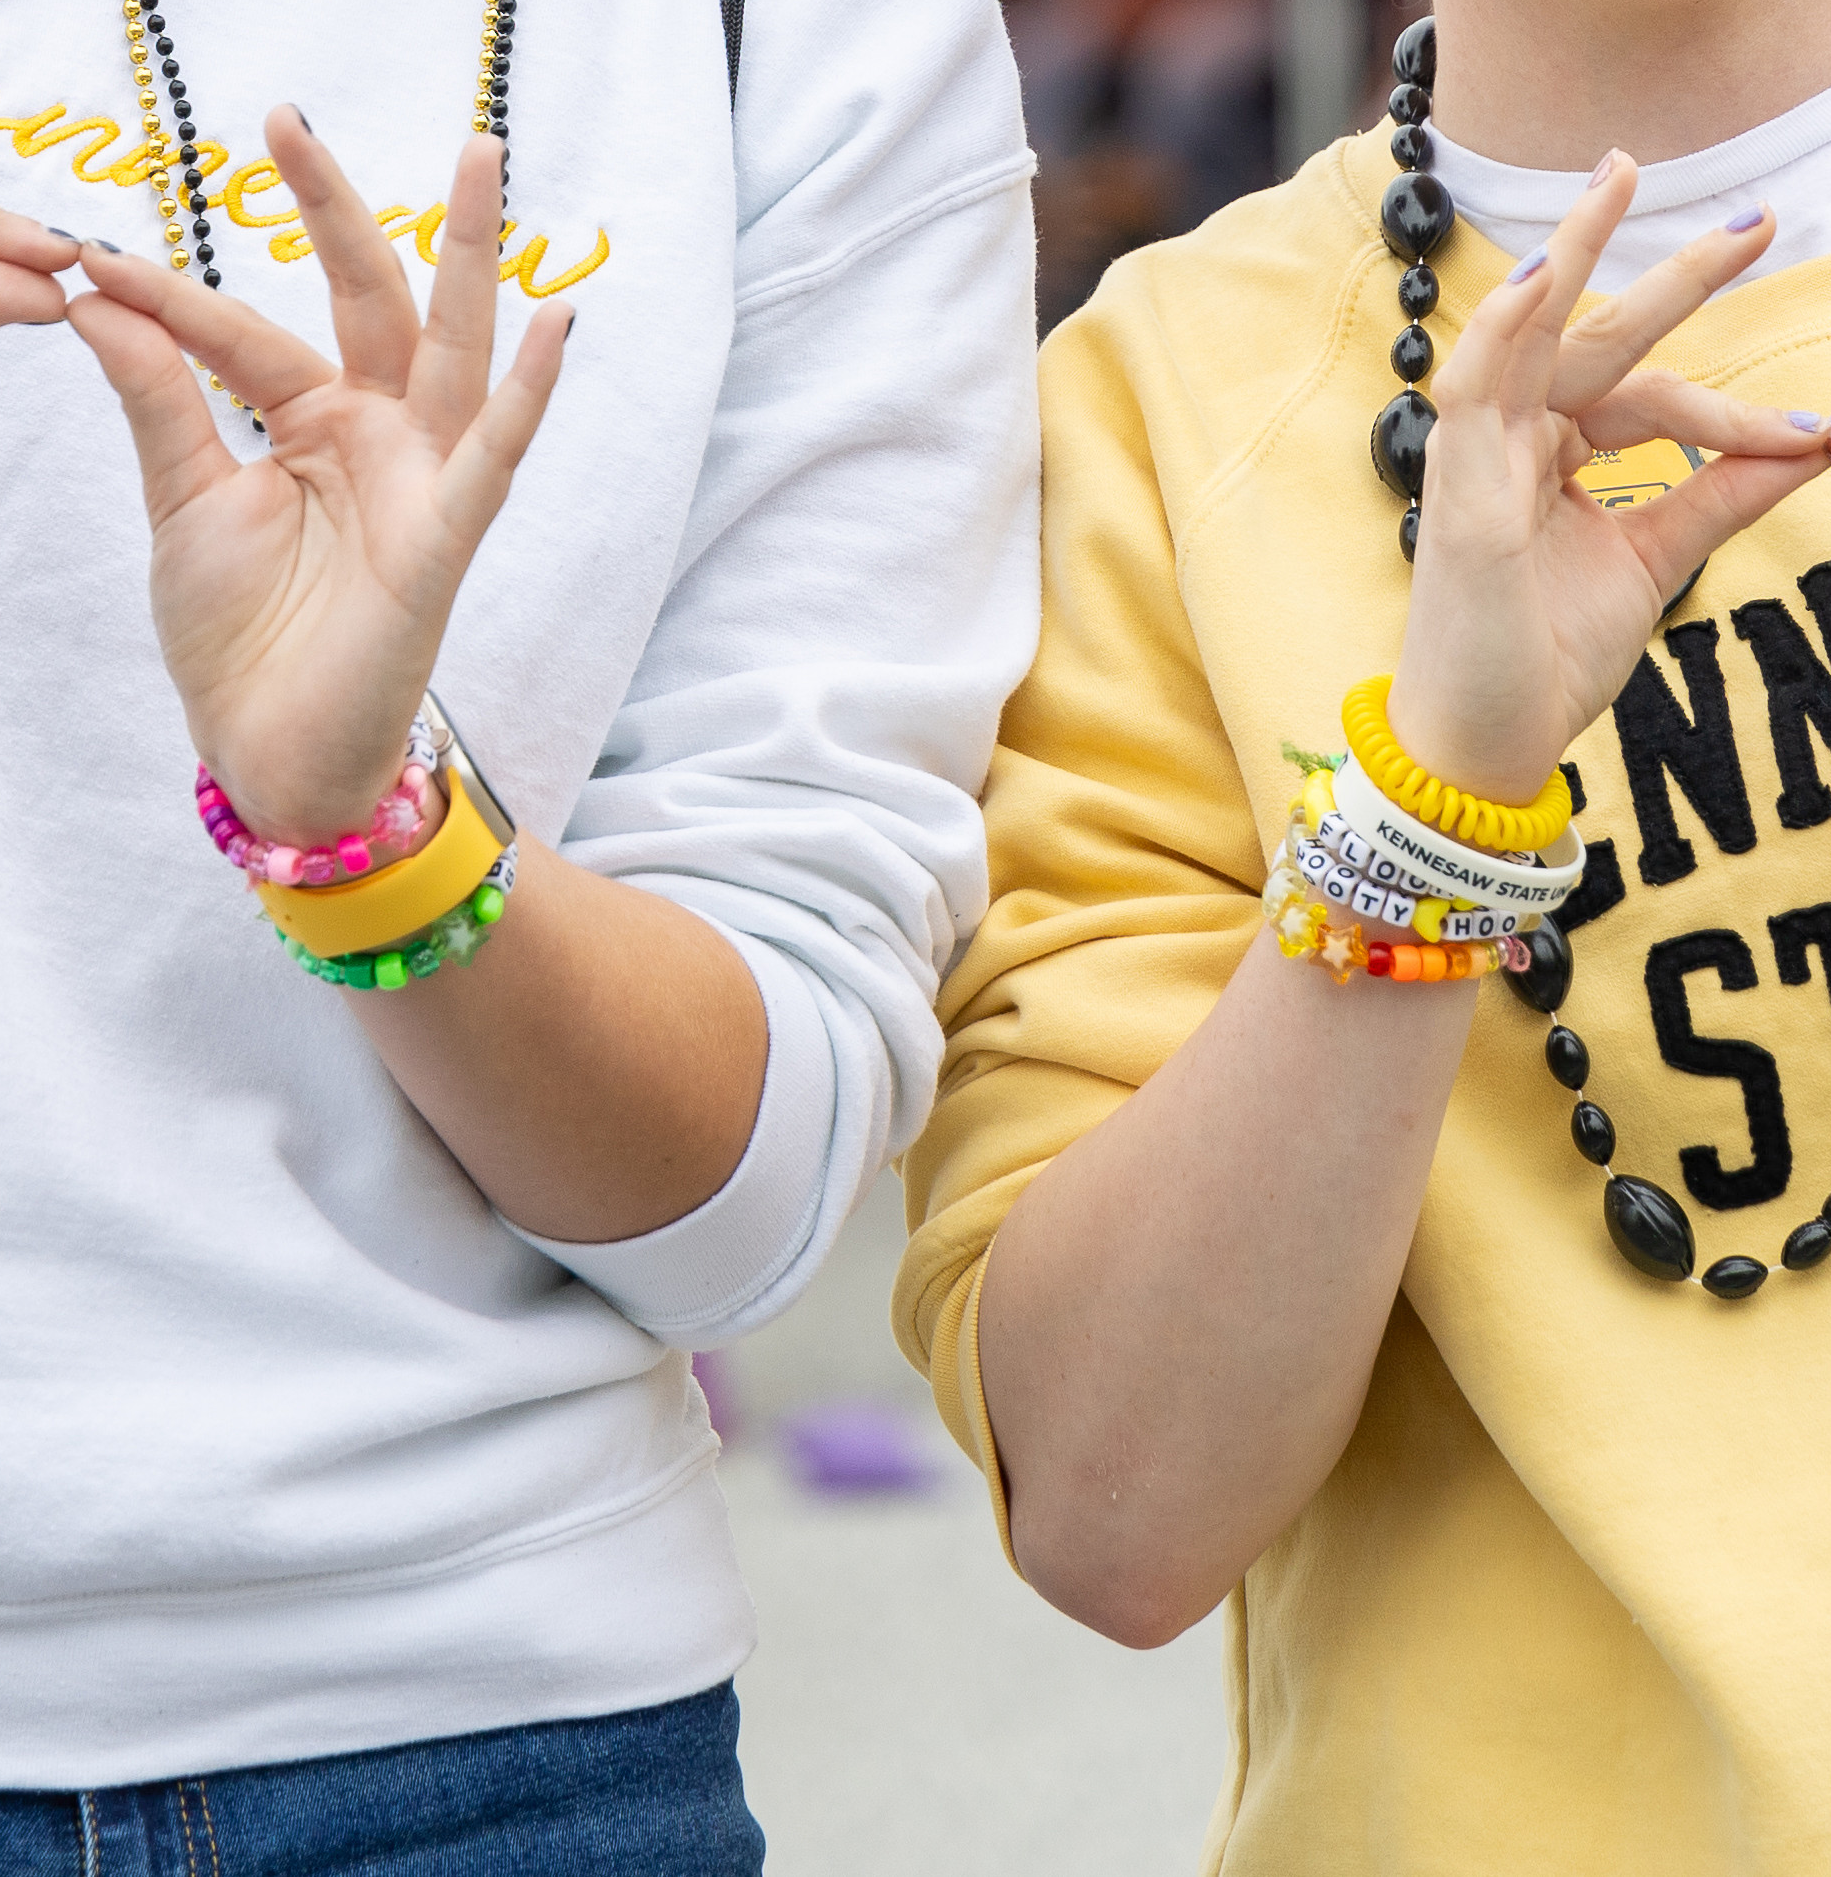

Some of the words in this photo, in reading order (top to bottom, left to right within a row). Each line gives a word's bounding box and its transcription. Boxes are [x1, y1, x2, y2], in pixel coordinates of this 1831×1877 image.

[1376, 820, 1495, 890] KENNESAW
[1495, 881, 1551, 901] STATE
[1454, 915, 1516, 940] HOO
